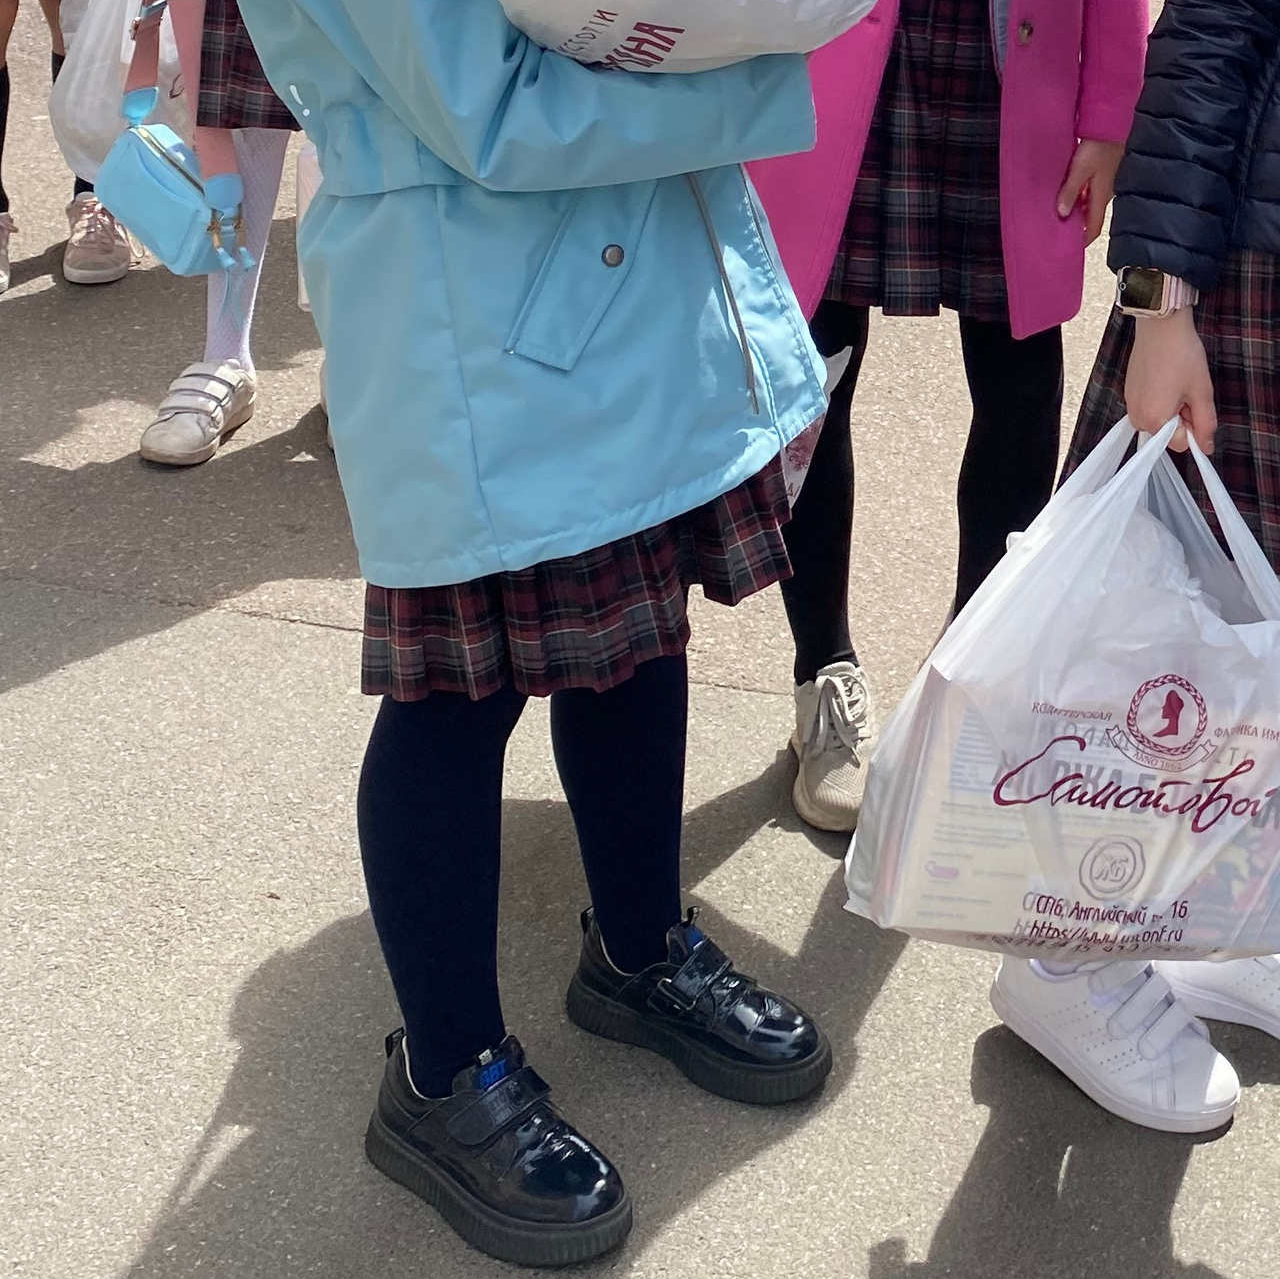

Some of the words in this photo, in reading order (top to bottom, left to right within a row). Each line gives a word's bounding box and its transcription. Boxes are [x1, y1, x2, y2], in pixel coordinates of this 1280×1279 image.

[1132, 751, 1159, 767] ANNO
[1160, 758, 1183, 771] 1862
[1171, 900, 1189, 919] 16
